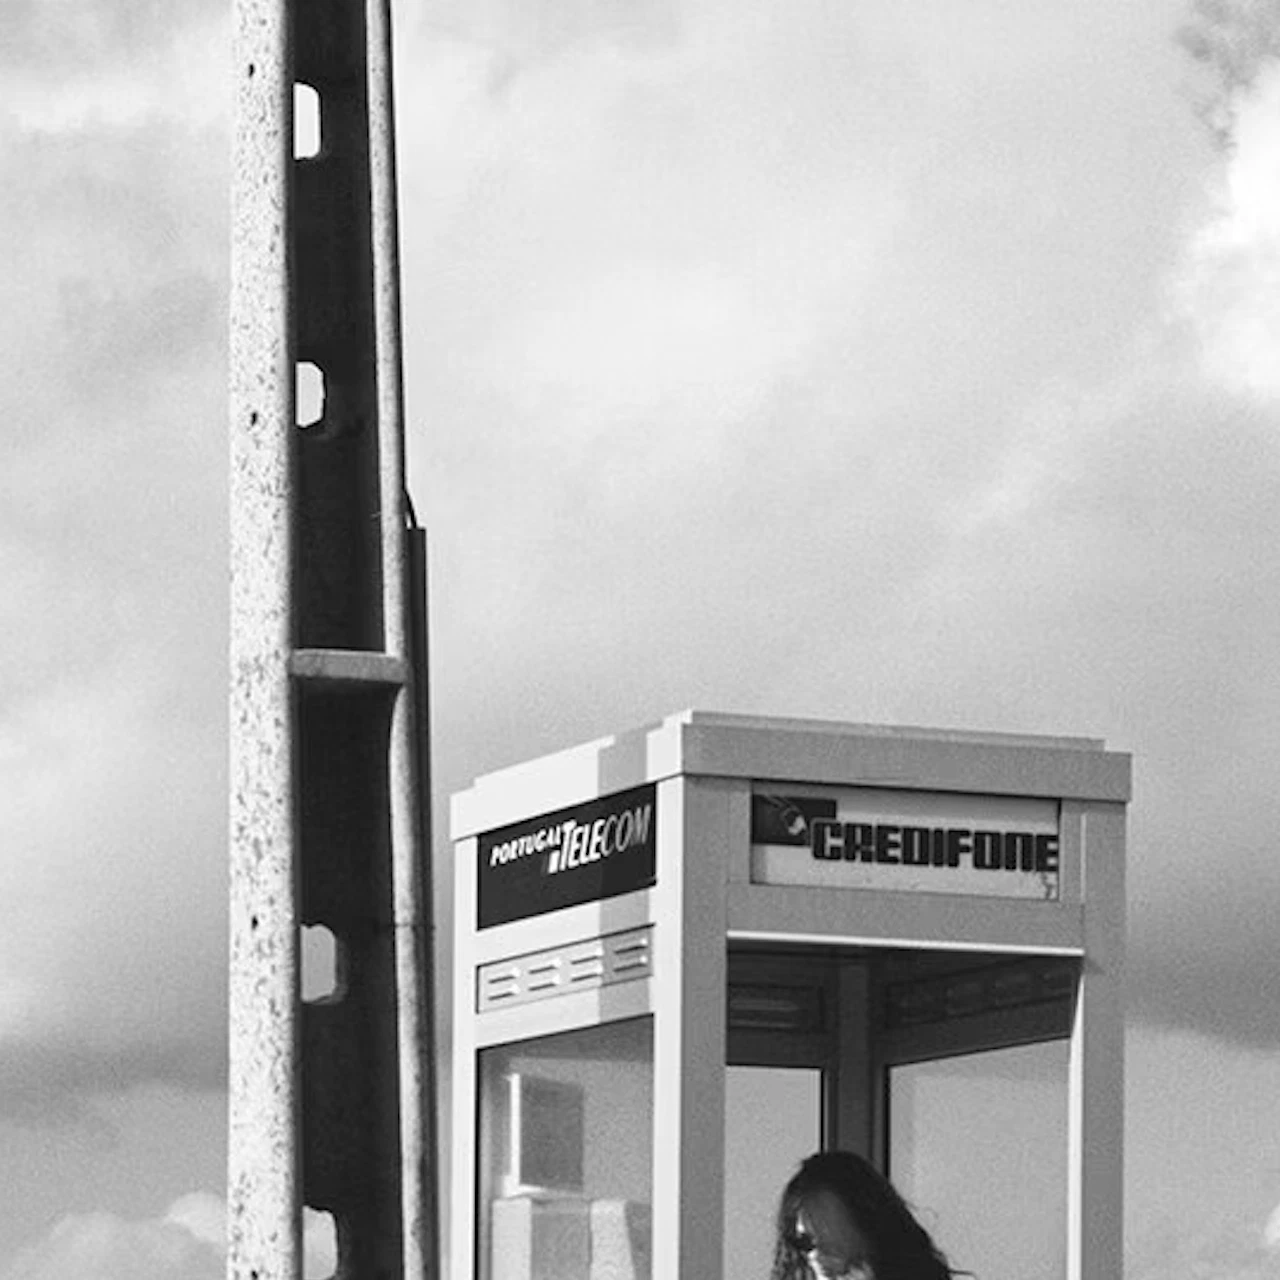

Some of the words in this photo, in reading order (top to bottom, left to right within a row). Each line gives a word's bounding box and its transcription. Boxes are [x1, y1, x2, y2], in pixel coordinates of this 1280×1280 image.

[489, 824, 562, 868] PORTUGAL
[558, 803, 652, 873] TELECOM
[812, 820, 1059, 872] CREDIFONE
